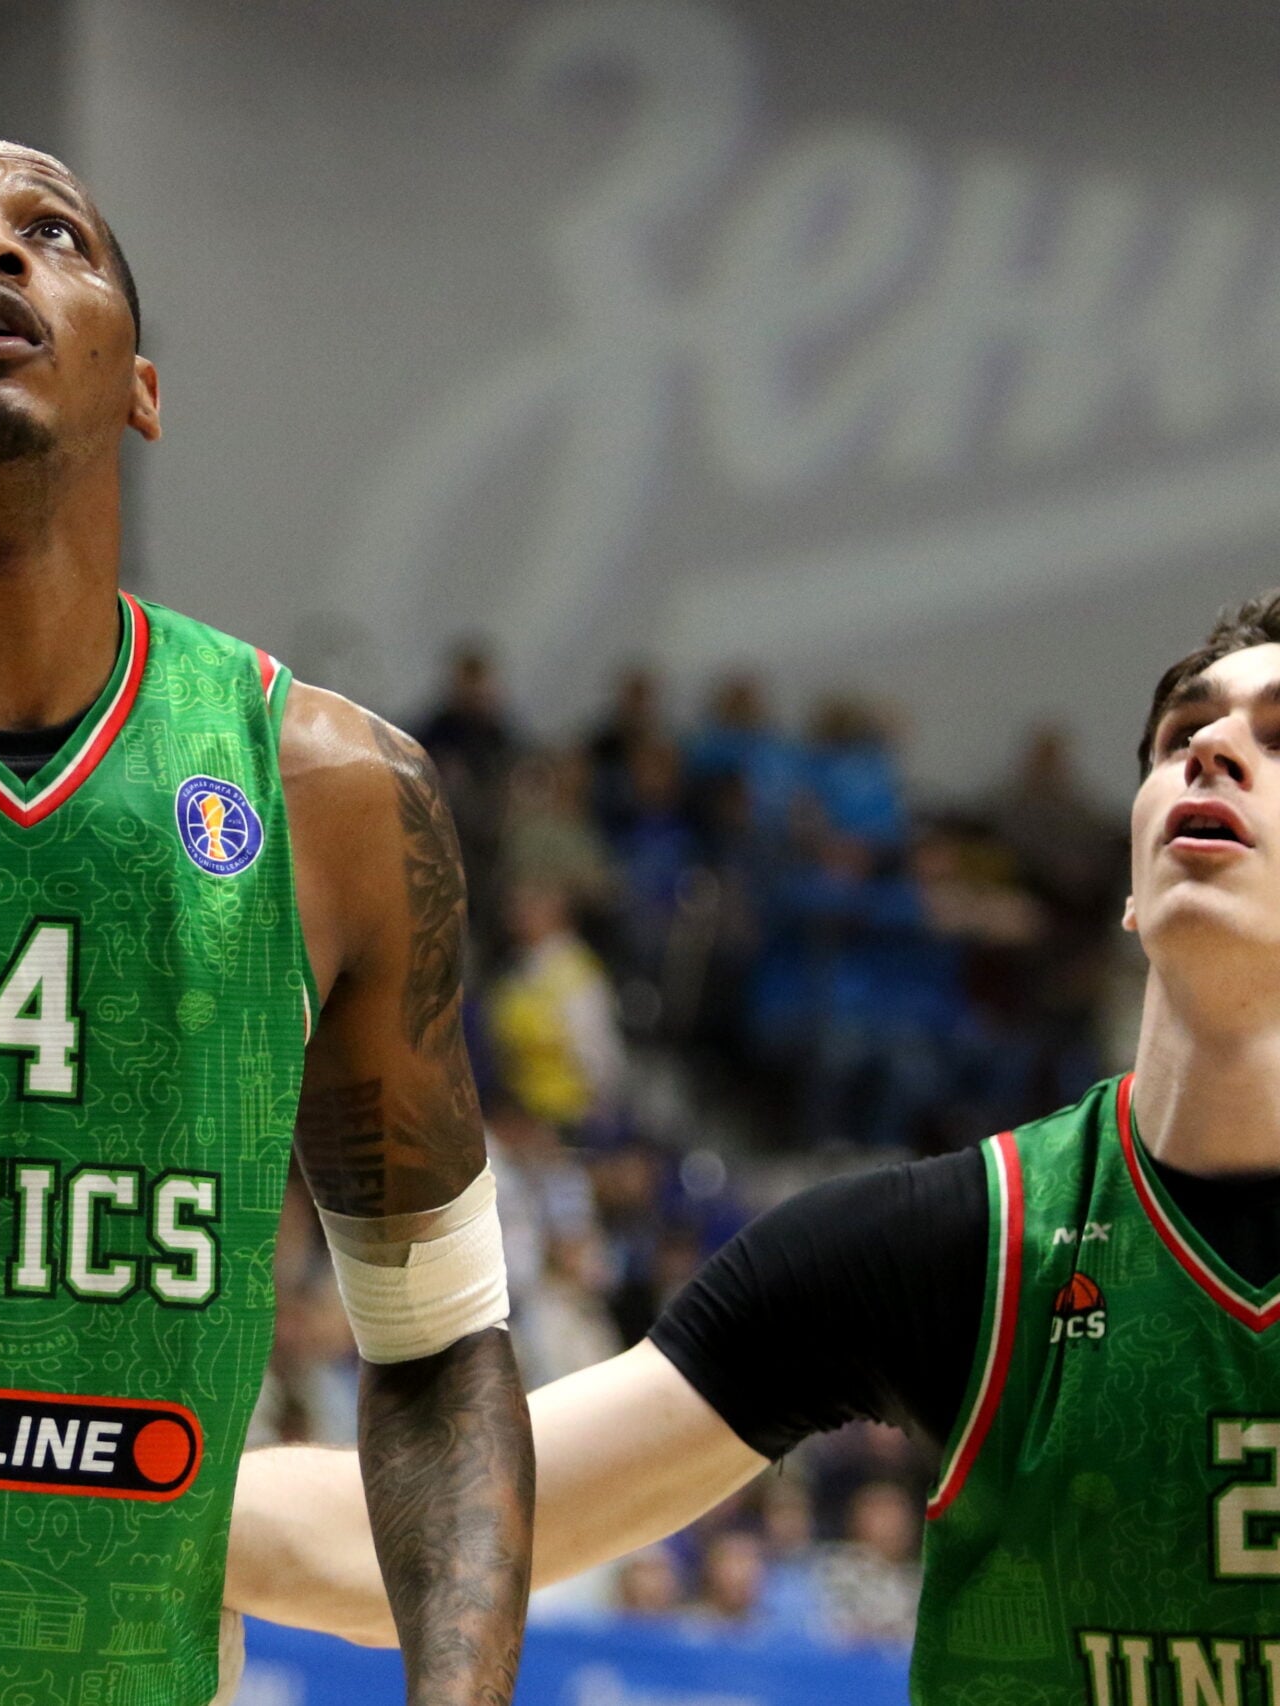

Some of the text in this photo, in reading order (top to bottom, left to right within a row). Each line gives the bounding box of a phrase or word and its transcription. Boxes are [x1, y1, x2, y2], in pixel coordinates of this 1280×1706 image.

[198, 856, 225, 871] UNITED
[226, 849, 252, 871] LEAGUE
[1212, 1416, 1280, 1581] 2
